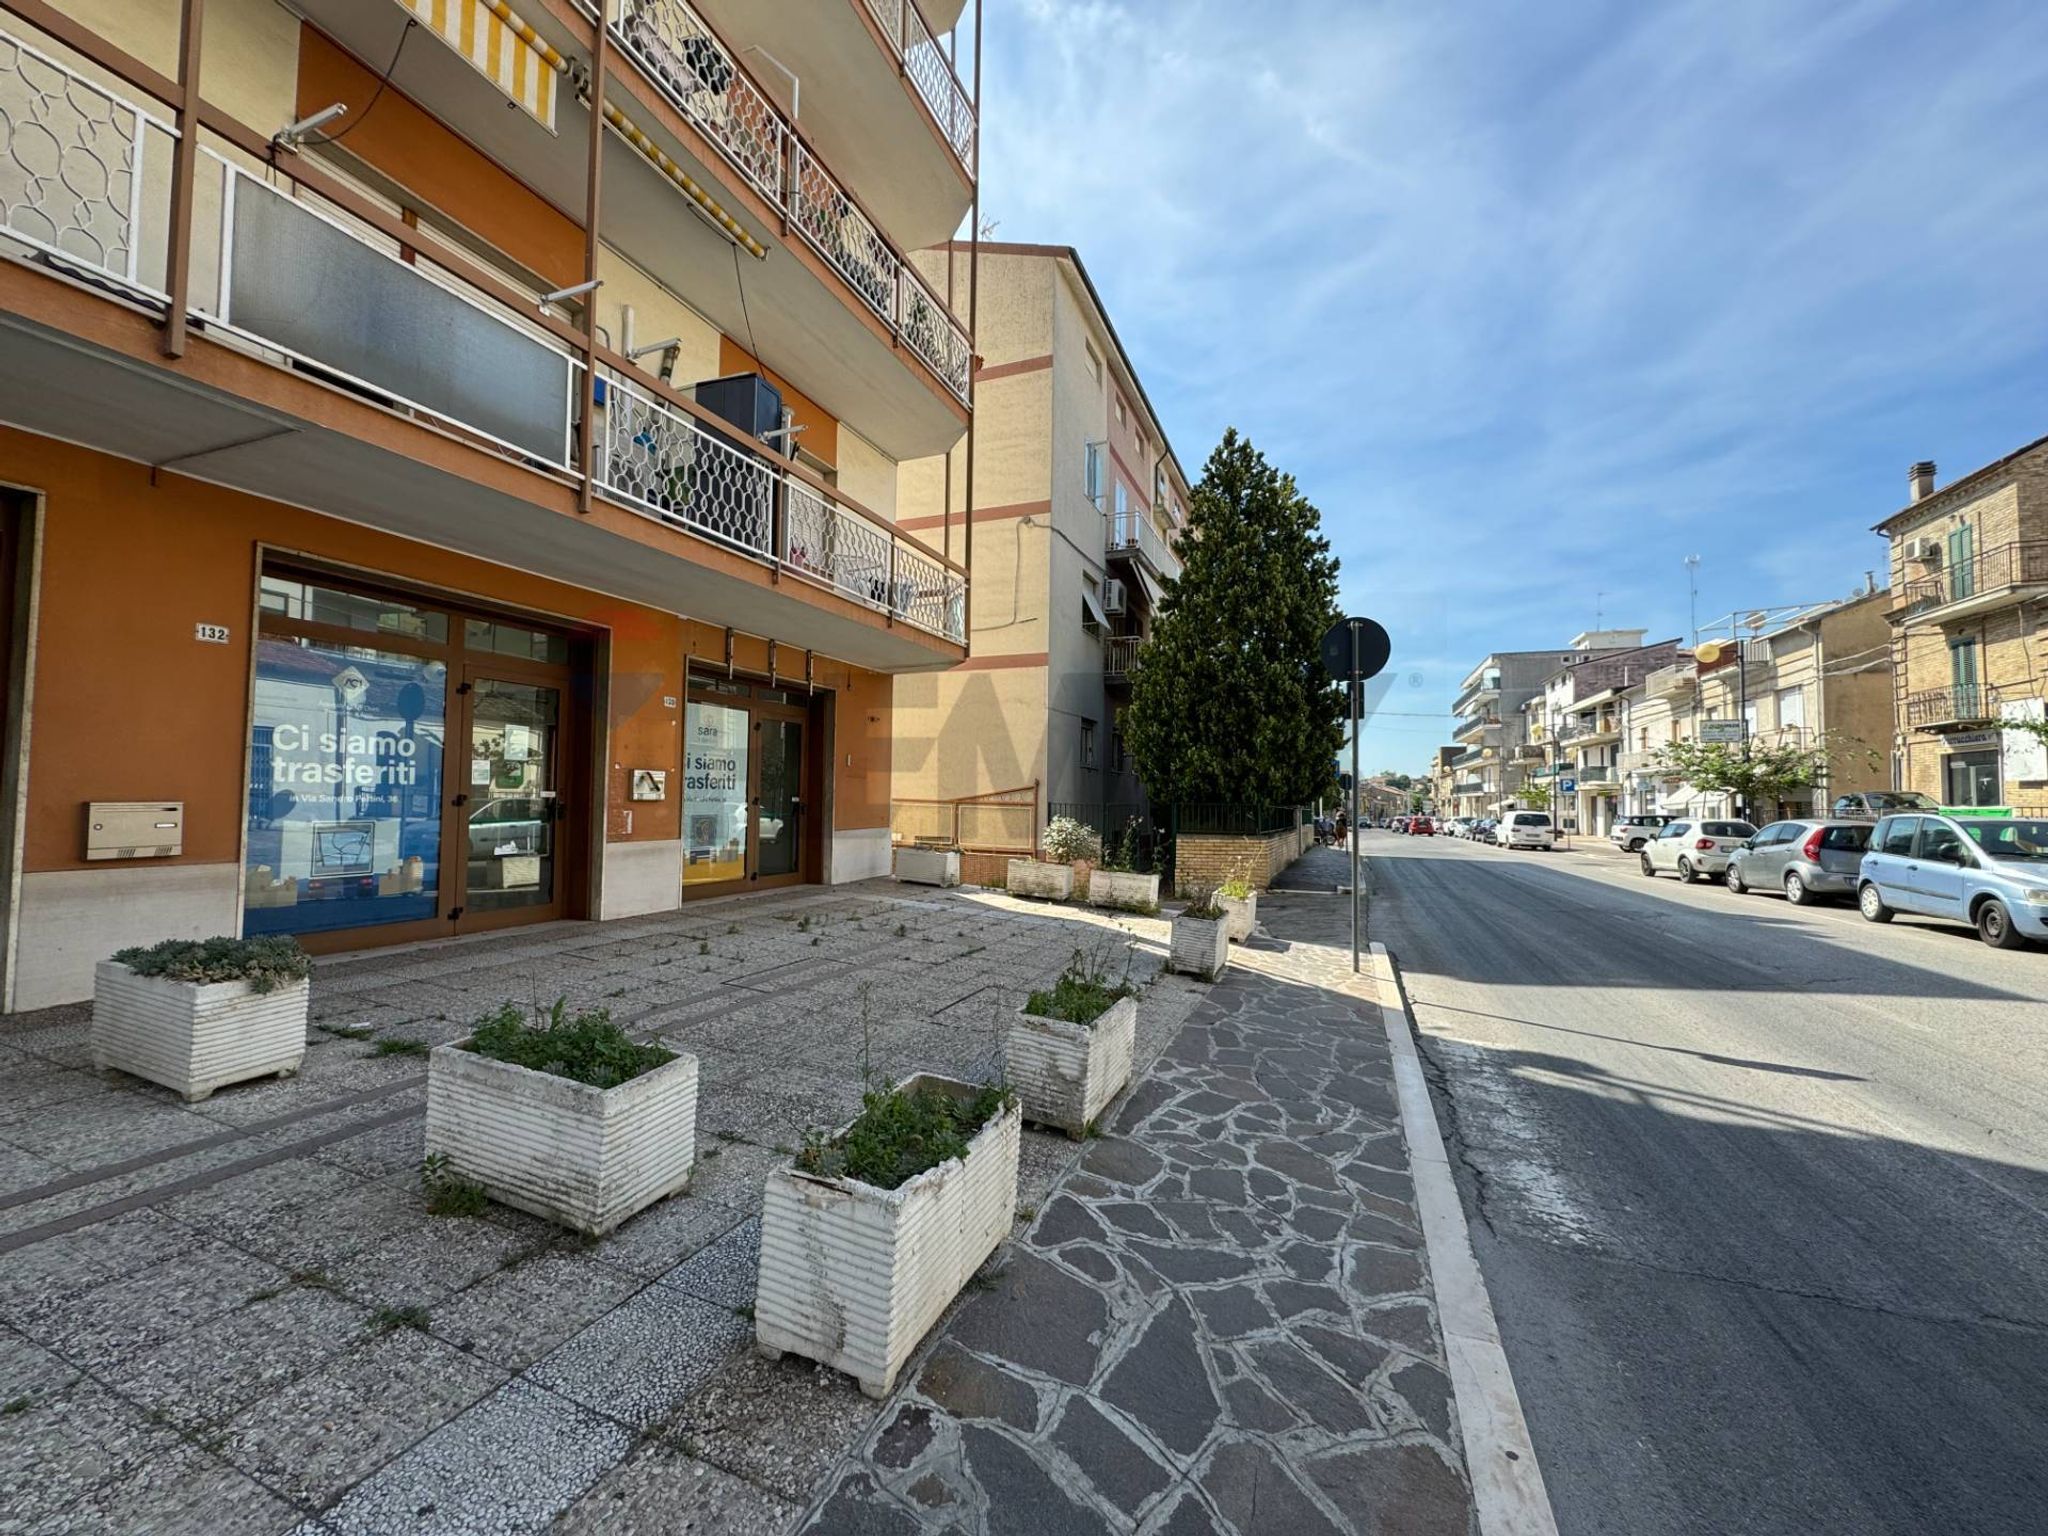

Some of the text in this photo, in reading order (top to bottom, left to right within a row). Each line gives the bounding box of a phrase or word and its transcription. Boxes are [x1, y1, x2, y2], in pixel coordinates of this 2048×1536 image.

[201, 626, 225, 640] 132
[698, 726, 718, 737] sara
[273, 724, 416, 757] Ci siamo
[695, 753, 736, 771] siamo
[271, 756, 416, 785] trasferiti
[685, 772, 736, 790] asferiti
[1562, 780, 1572, 791] P
[301, 793, 317, 803] Via
